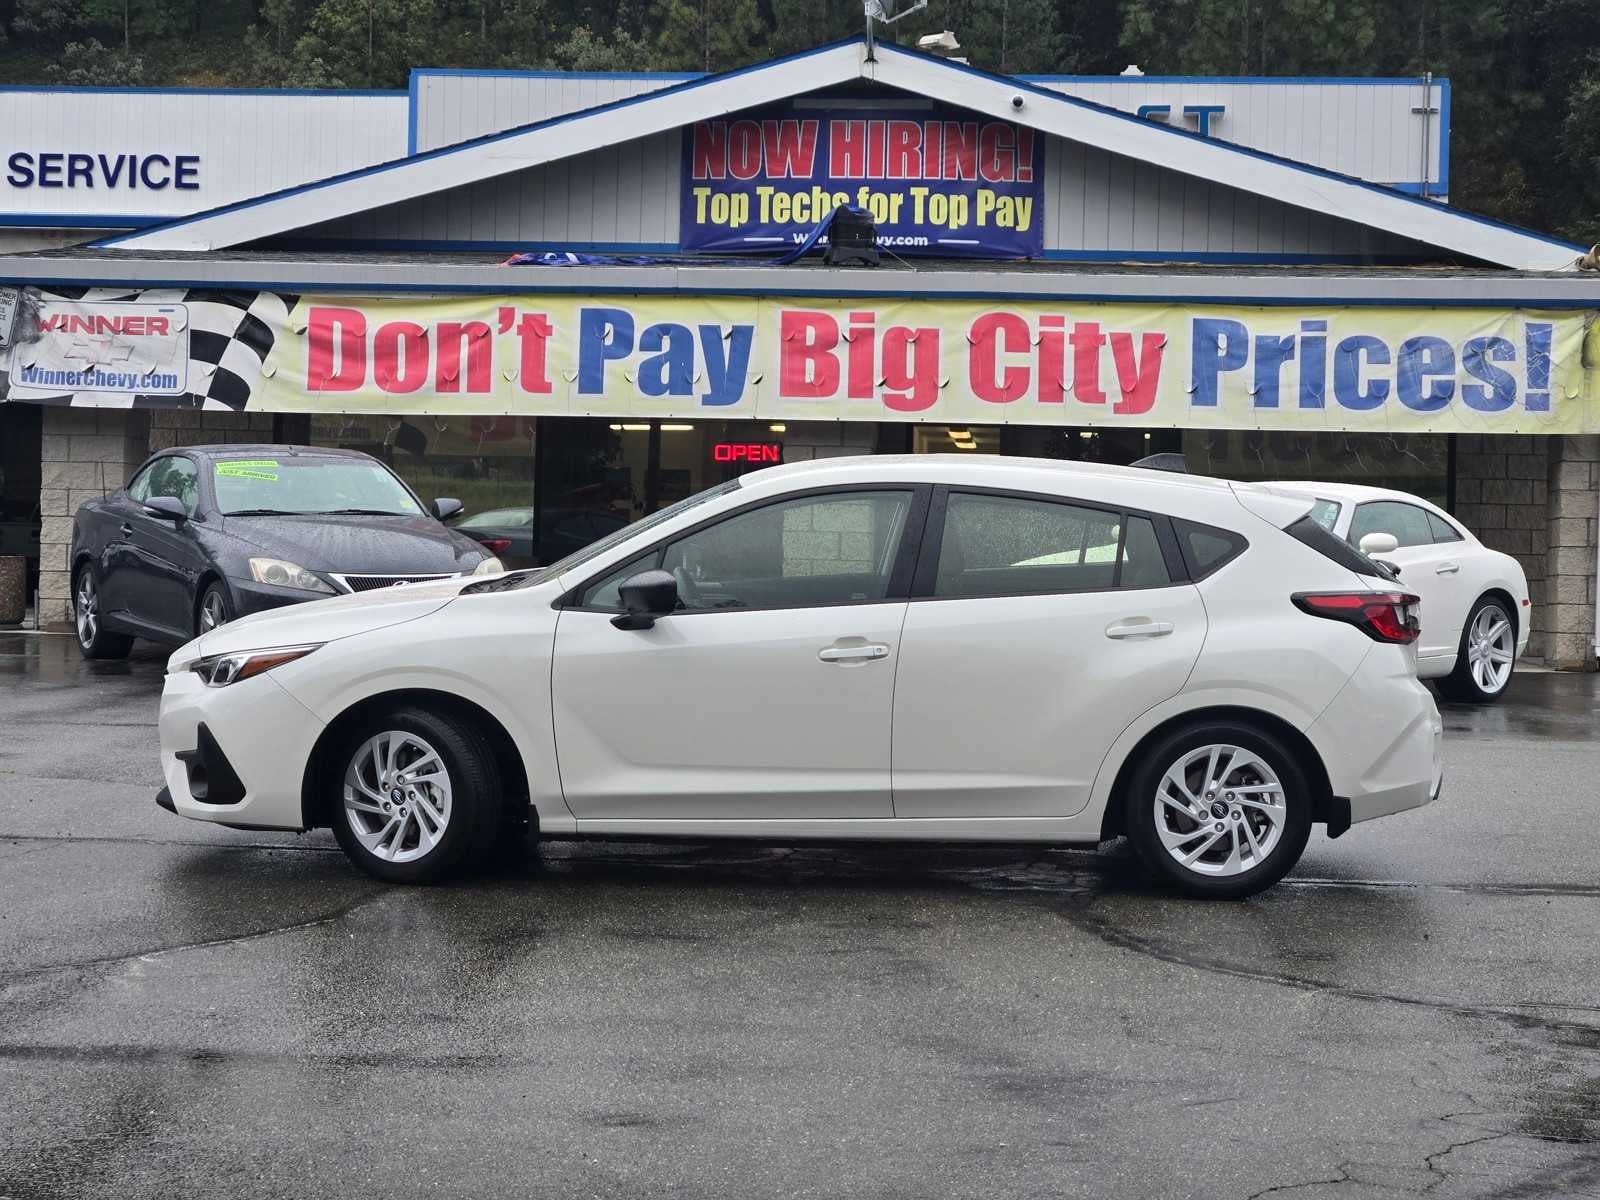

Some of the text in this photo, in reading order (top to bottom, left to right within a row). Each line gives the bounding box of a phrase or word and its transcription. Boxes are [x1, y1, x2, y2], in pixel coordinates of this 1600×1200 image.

[692, 119, 1034, 183] NOW HIRING!
[7, 152, 201, 190] SERVICE
[694, 186, 1033, 231] Top Techs for Top Pay
[32, 314, 169, 336] WINNER
[20, 366, 178, 389] WinnerChevy.com
[306, 306, 1552, 414] Don't Pay Big City Prices!
[714, 443, 779, 461] OPEN
